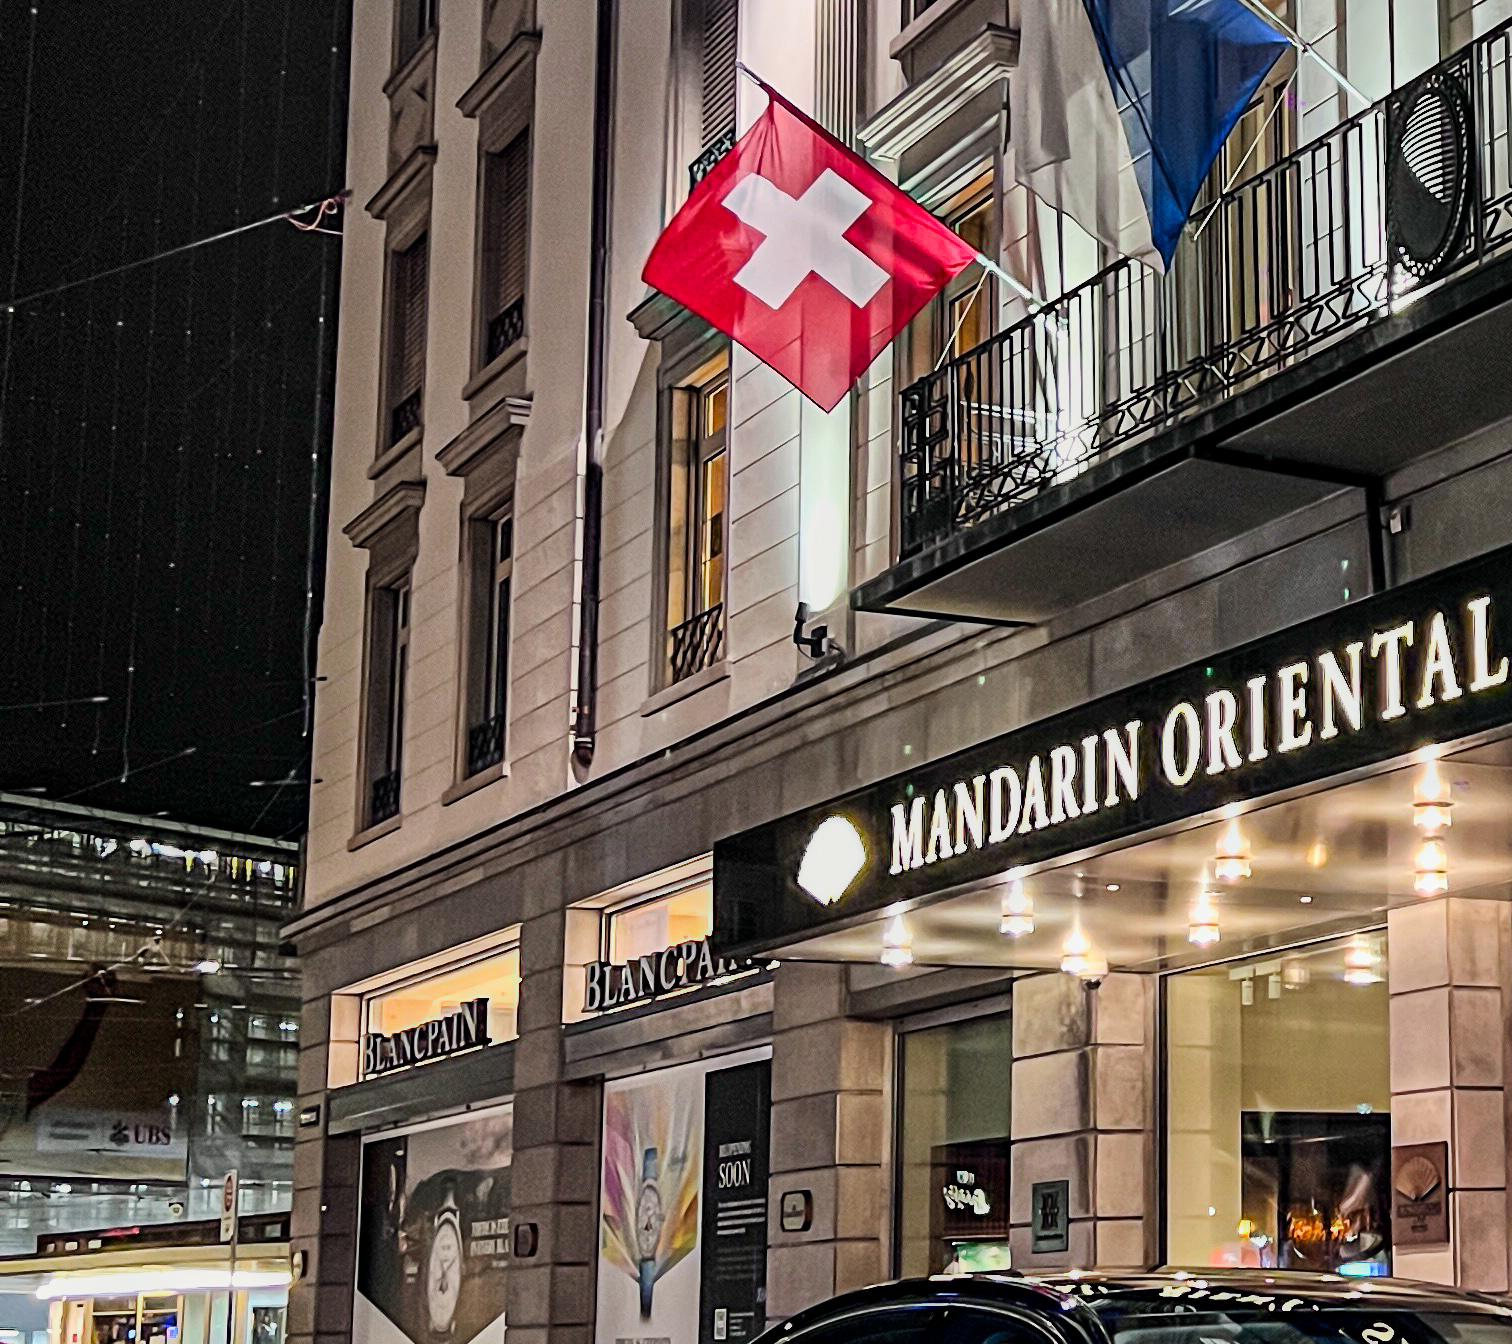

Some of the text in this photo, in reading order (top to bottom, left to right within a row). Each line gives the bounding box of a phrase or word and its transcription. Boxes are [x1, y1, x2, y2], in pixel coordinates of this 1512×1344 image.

[889, 719, 1142, 876] MANDARIN
[1161, 595, 1508, 786] ORIENTAL
[584, 936, 752, 1012] BLANCPA
[363, 998, 487, 1075] BLANCPAIN
[134, 1124, 171, 1146] UBS
[718, 1159, 751, 1189] SOON
